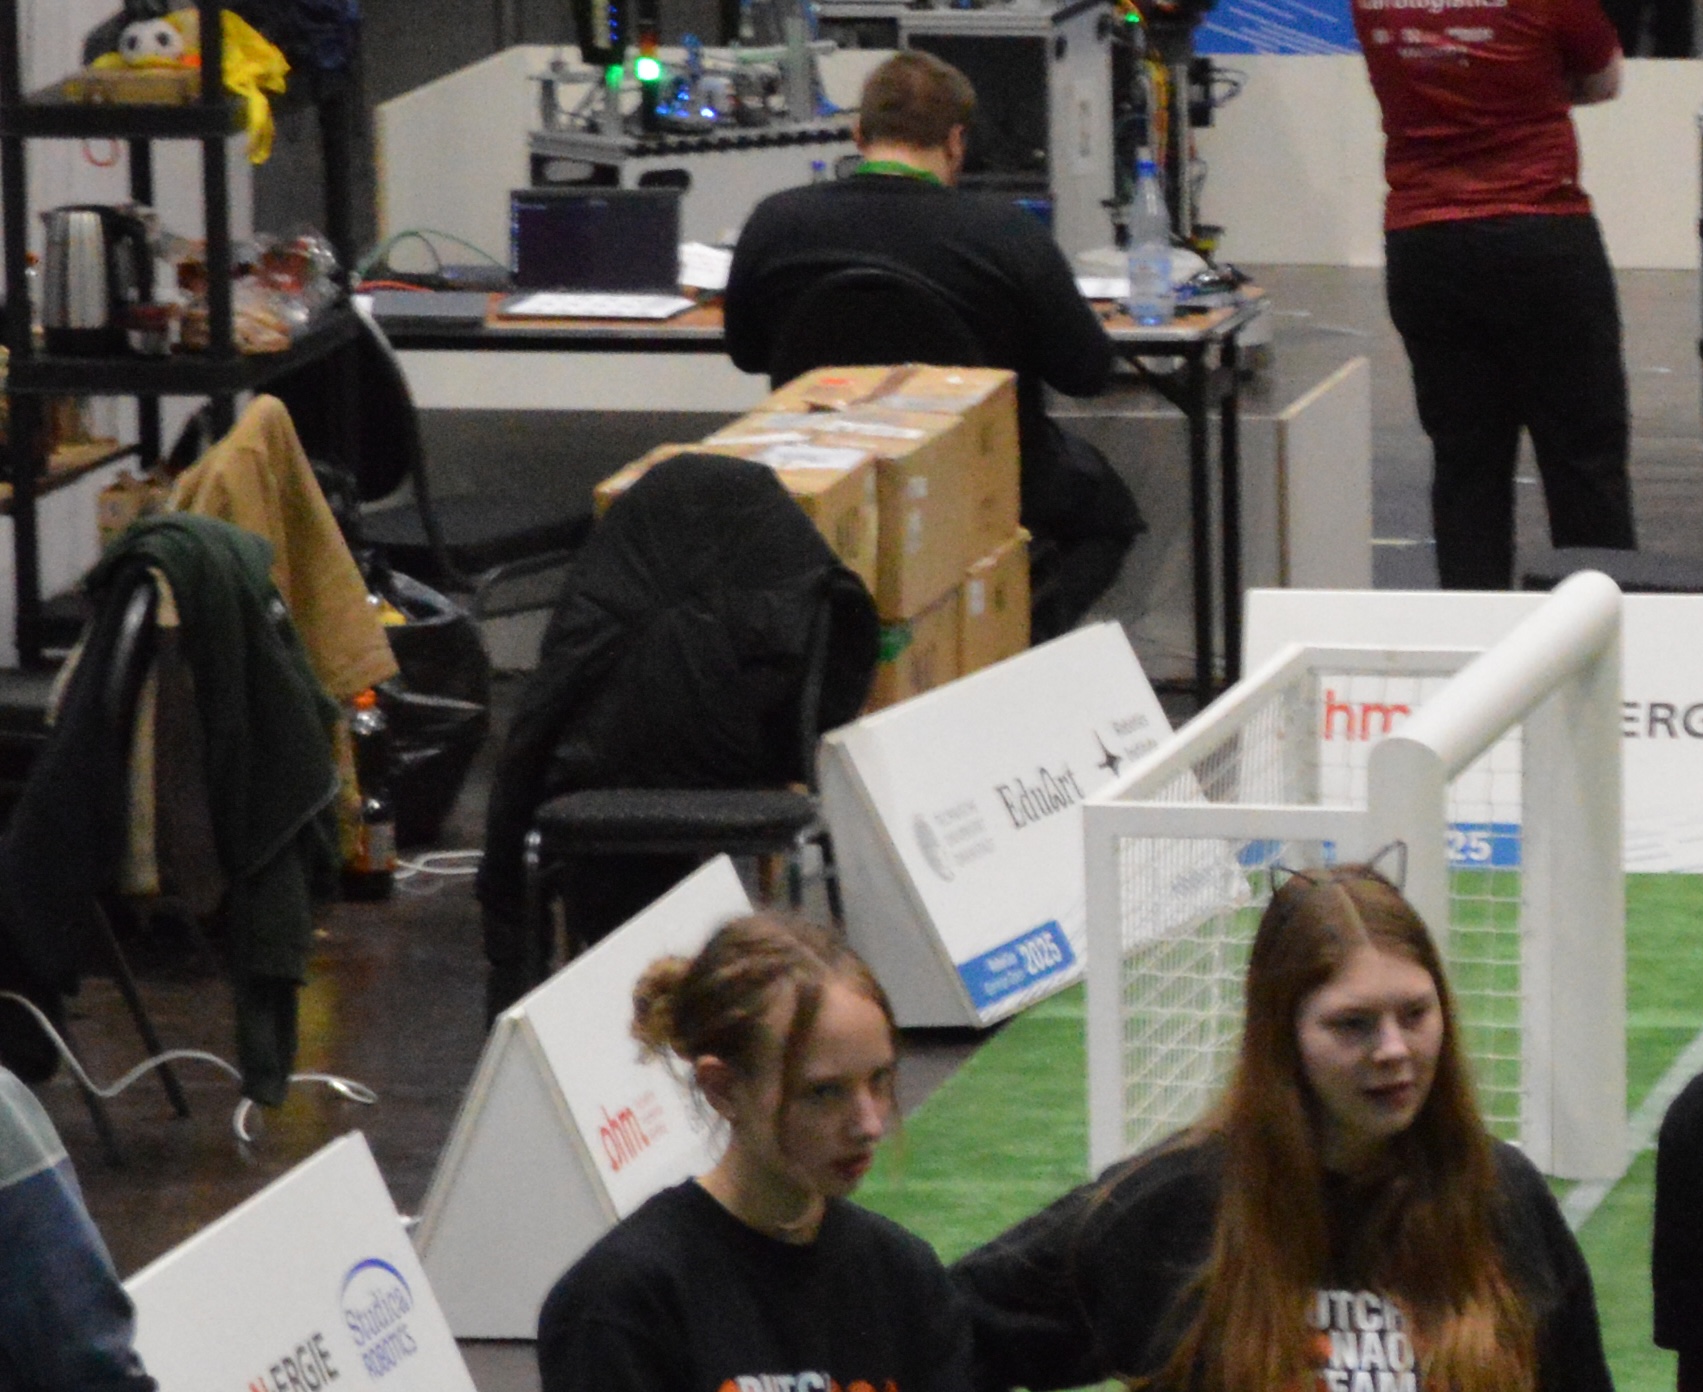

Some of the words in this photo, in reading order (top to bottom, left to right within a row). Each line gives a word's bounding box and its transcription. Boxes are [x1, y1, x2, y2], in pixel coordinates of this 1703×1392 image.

[1018, 930, 1063, 976] 2025
[344, 1287, 412, 1347] Studica
[1329, 1330, 1415, 1372] NAO
